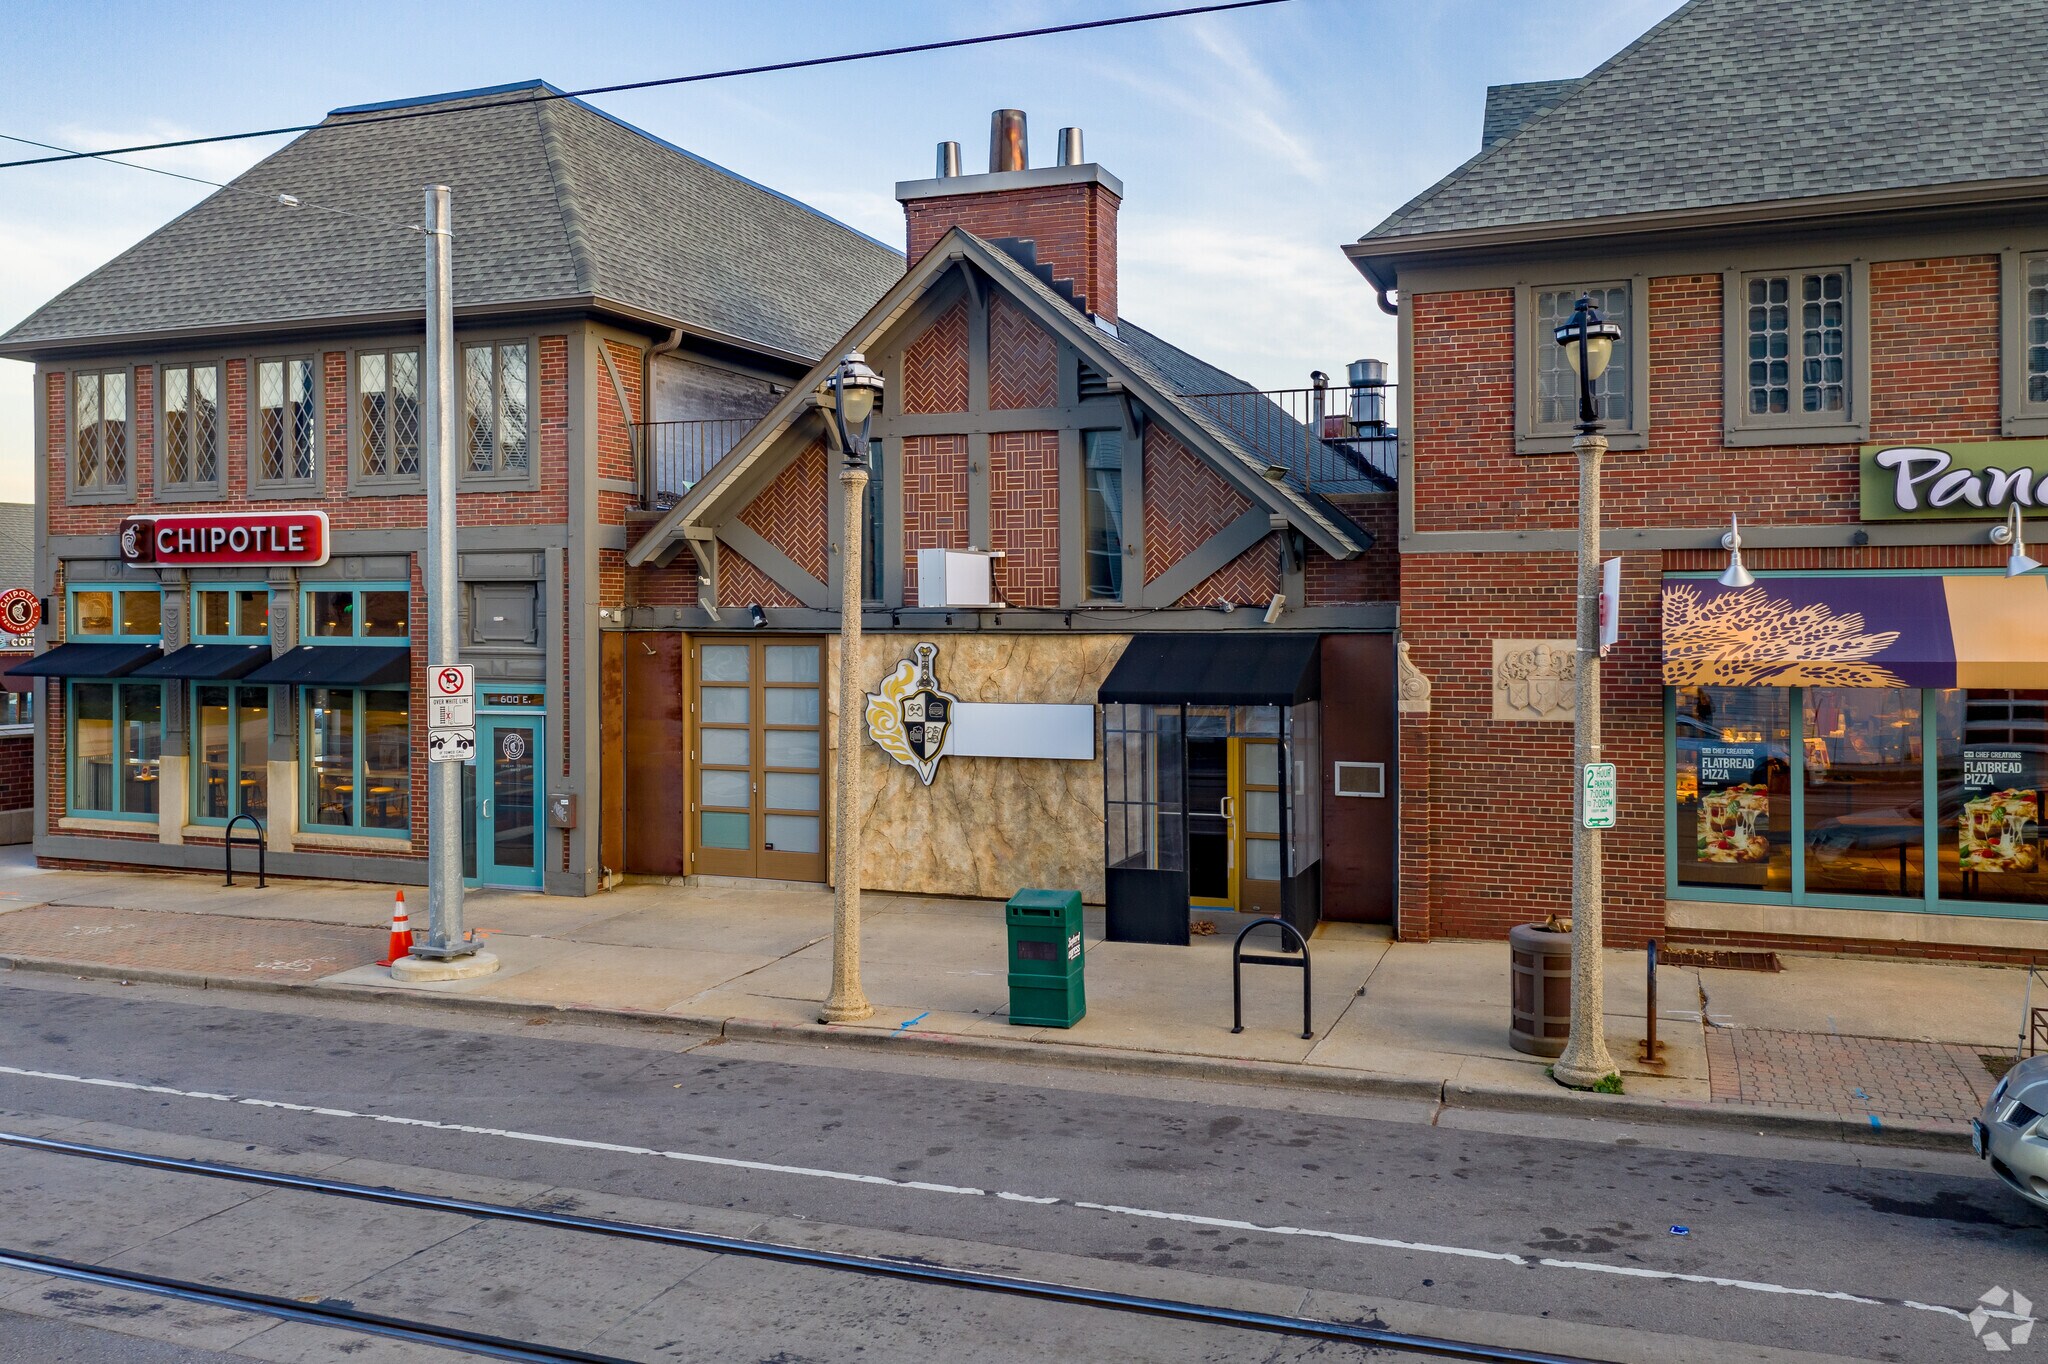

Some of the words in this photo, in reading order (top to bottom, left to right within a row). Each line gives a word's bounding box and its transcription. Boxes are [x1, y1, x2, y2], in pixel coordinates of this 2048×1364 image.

[157, 525, 304, 554] CHIPOTLE
[0, 590, 39, 608] CHIPOTLE
[1, 616, 25, 631] MEXICAN
[25, 616, 39, 630] GRILL
[500, 695, 519, 704] 600
[522, 695, 531, 704] E.
[1702, 757, 1754, 769] FLATBREAD
[1964, 762, 2021, 773] FLATBREAD
[1587, 770, 1594, 788] 2
[1597, 769, 1611, 777] HOUR
[1702, 769, 1729, 779] PIZZA
[1964, 774, 1993, 784] PIZZA
[1590, 790, 1609, 798] 7:00AM
[1593, 799, 1612, 807] 7:00PM
